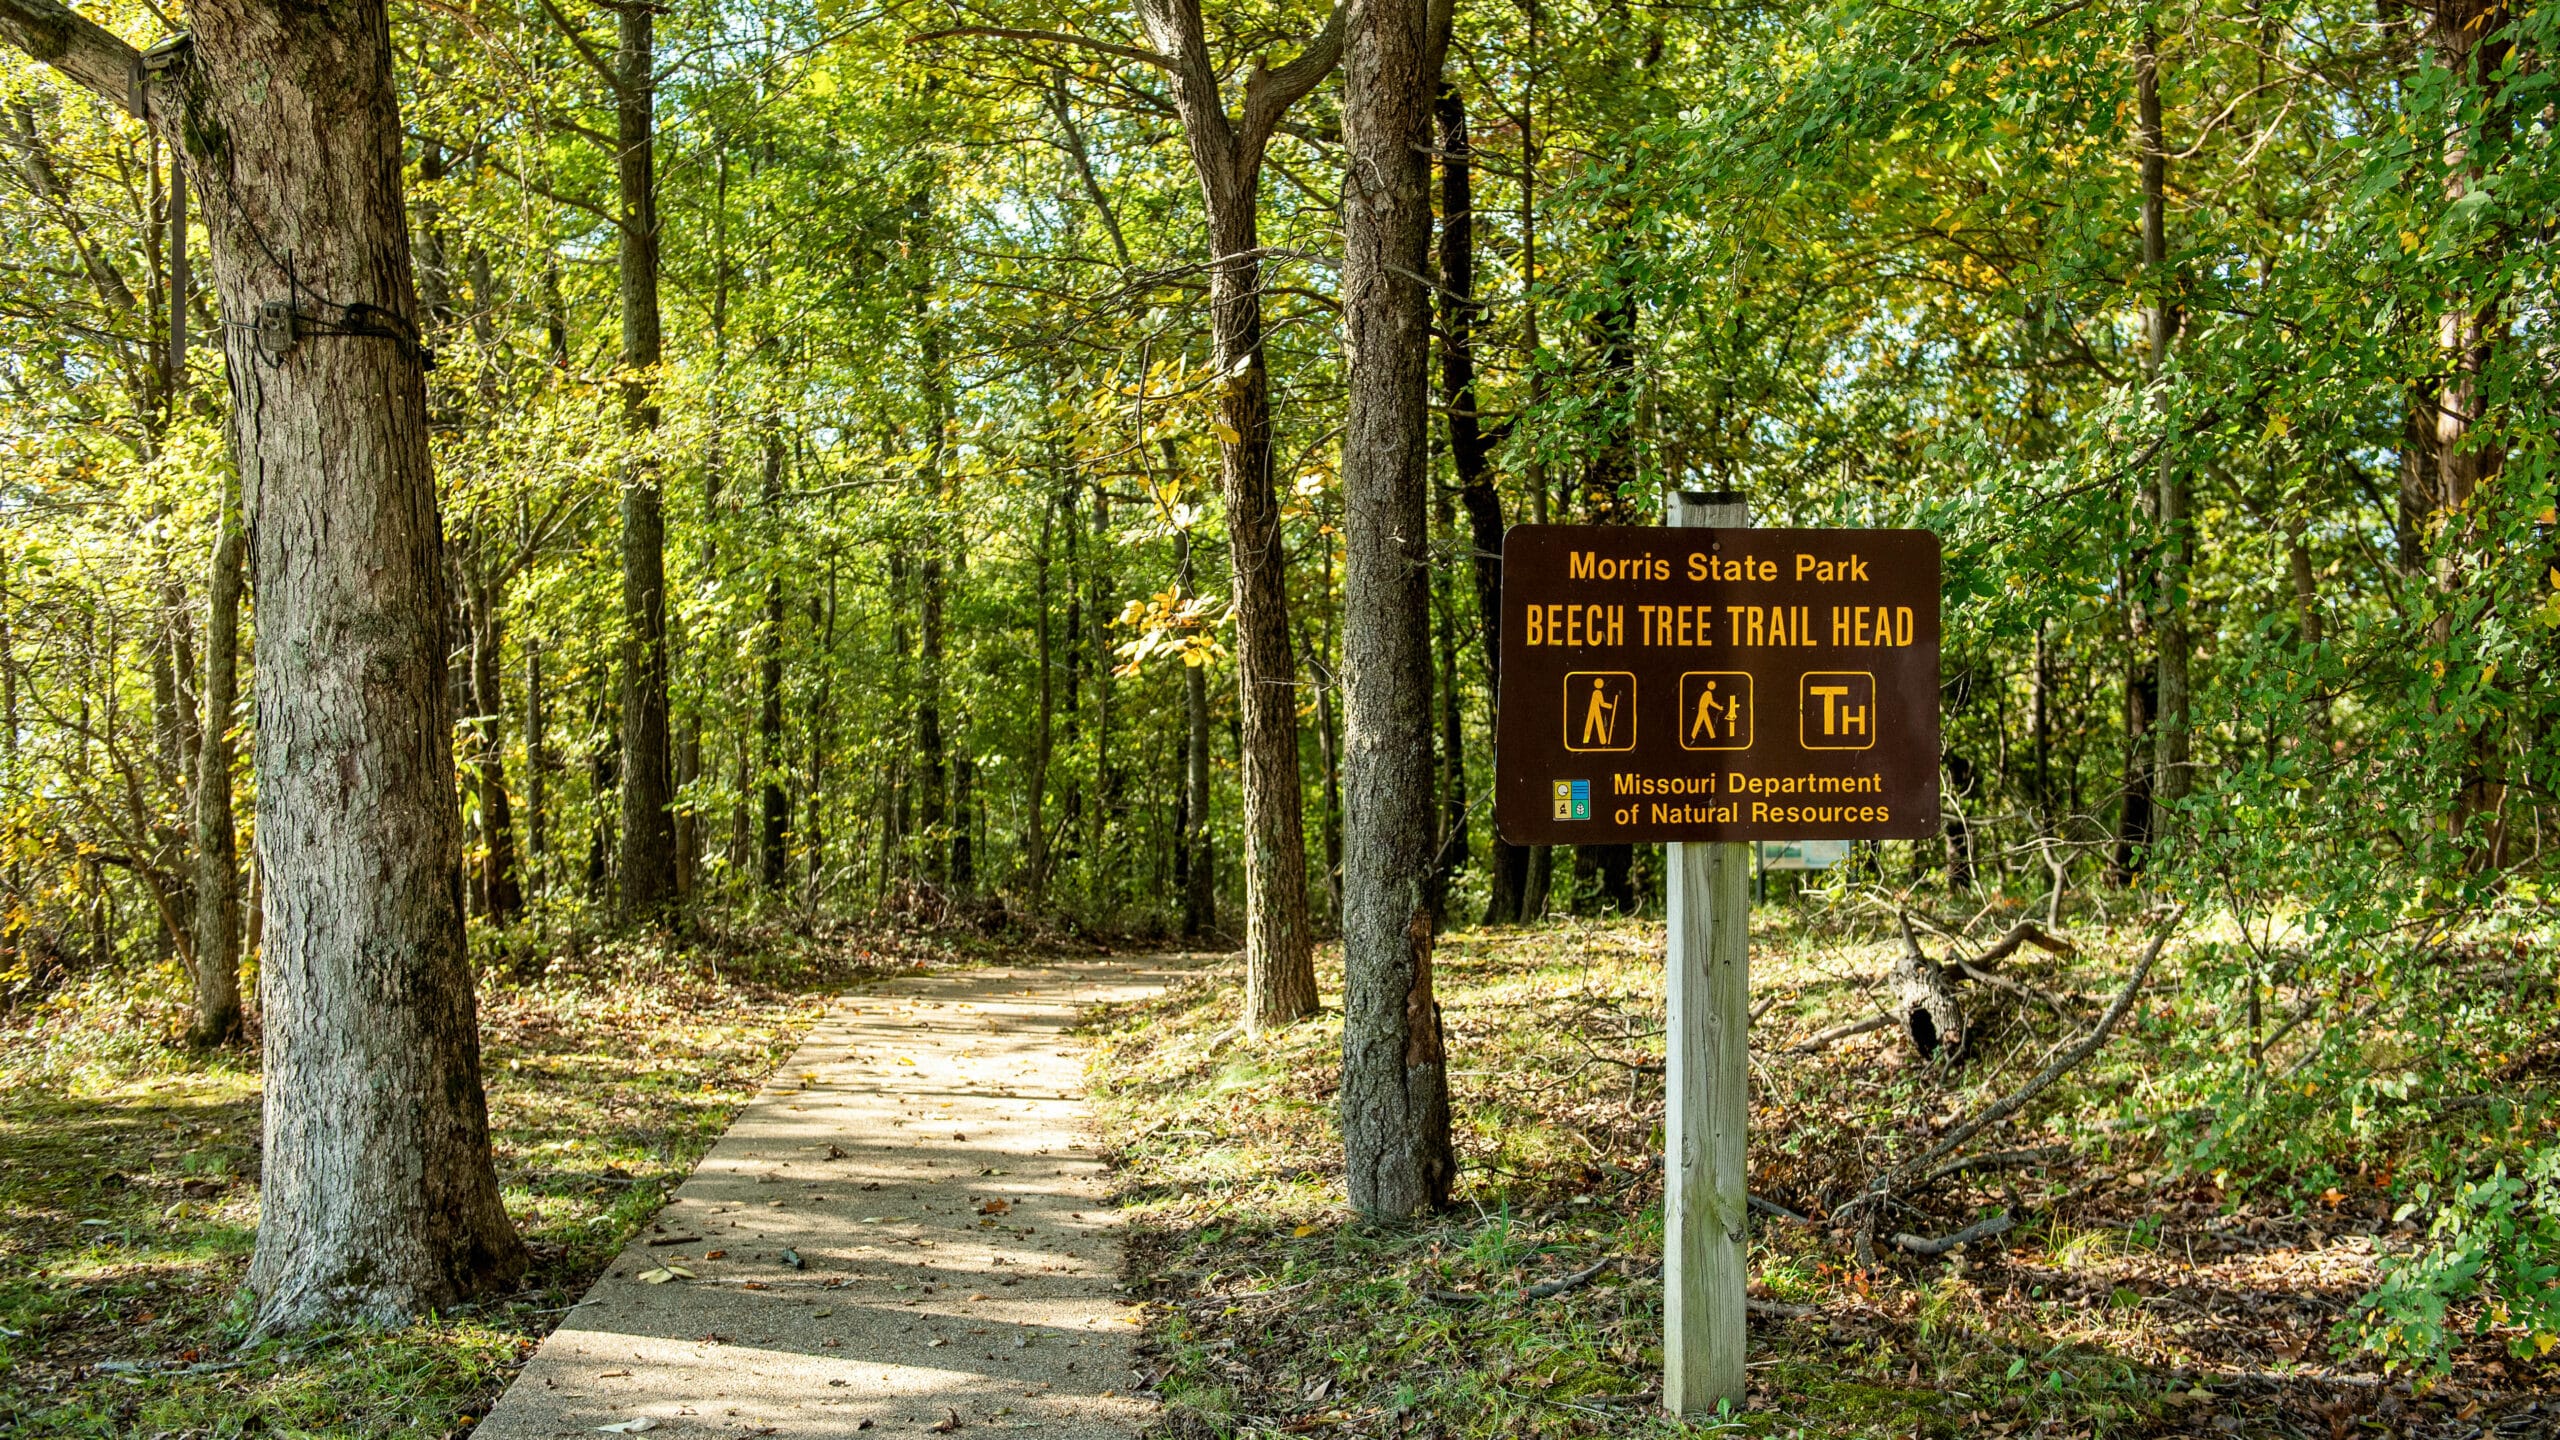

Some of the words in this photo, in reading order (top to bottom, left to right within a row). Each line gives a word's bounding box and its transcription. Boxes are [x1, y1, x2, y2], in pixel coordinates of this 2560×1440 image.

[1569, 551, 1671, 581] Morris
[1687, 552, 1778, 582] State
[1795, 553, 1870, 582] Park
[1526, 604, 1624, 647] BEECH
[1638, 605, 1713, 647] TREE
[1726, 605, 1818, 647] TRAIL
[1832, 606, 1914, 647] HEAD
[1809, 685, 1866, 736] TH
[1614, 772, 1716, 795] Missouri
[1728, 772, 1882, 798] Department
[1614, 803, 1640, 825] of
[1651, 801, 1738, 824] Natural
[1751, 801, 1890, 823] Resources
